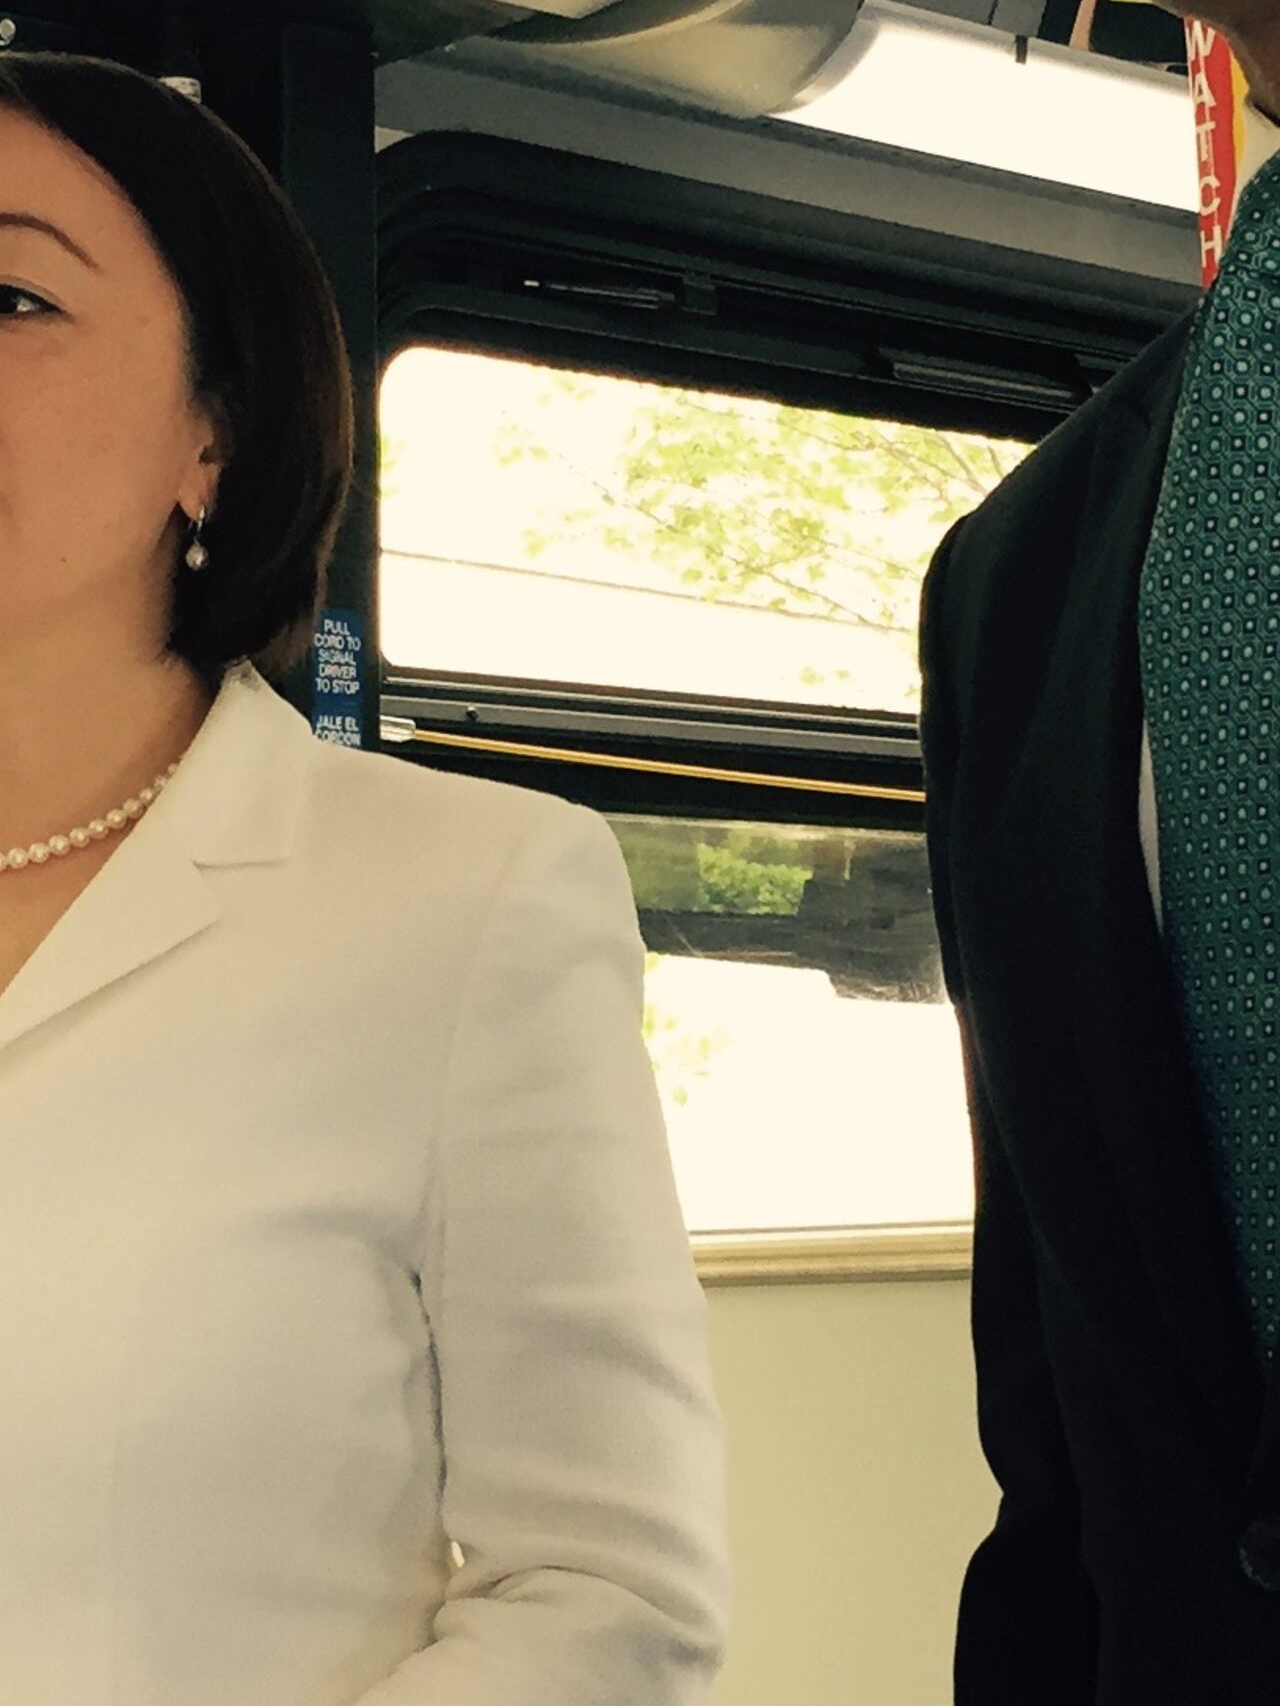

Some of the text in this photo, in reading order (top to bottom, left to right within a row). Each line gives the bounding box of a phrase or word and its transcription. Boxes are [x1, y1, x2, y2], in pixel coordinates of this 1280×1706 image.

[324, 619, 350, 636] PULL
[314, 634, 361, 651] CORD TO
[318, 663, 357, 679] DRIVER
[315, 678, 360, 695] TO STOP
